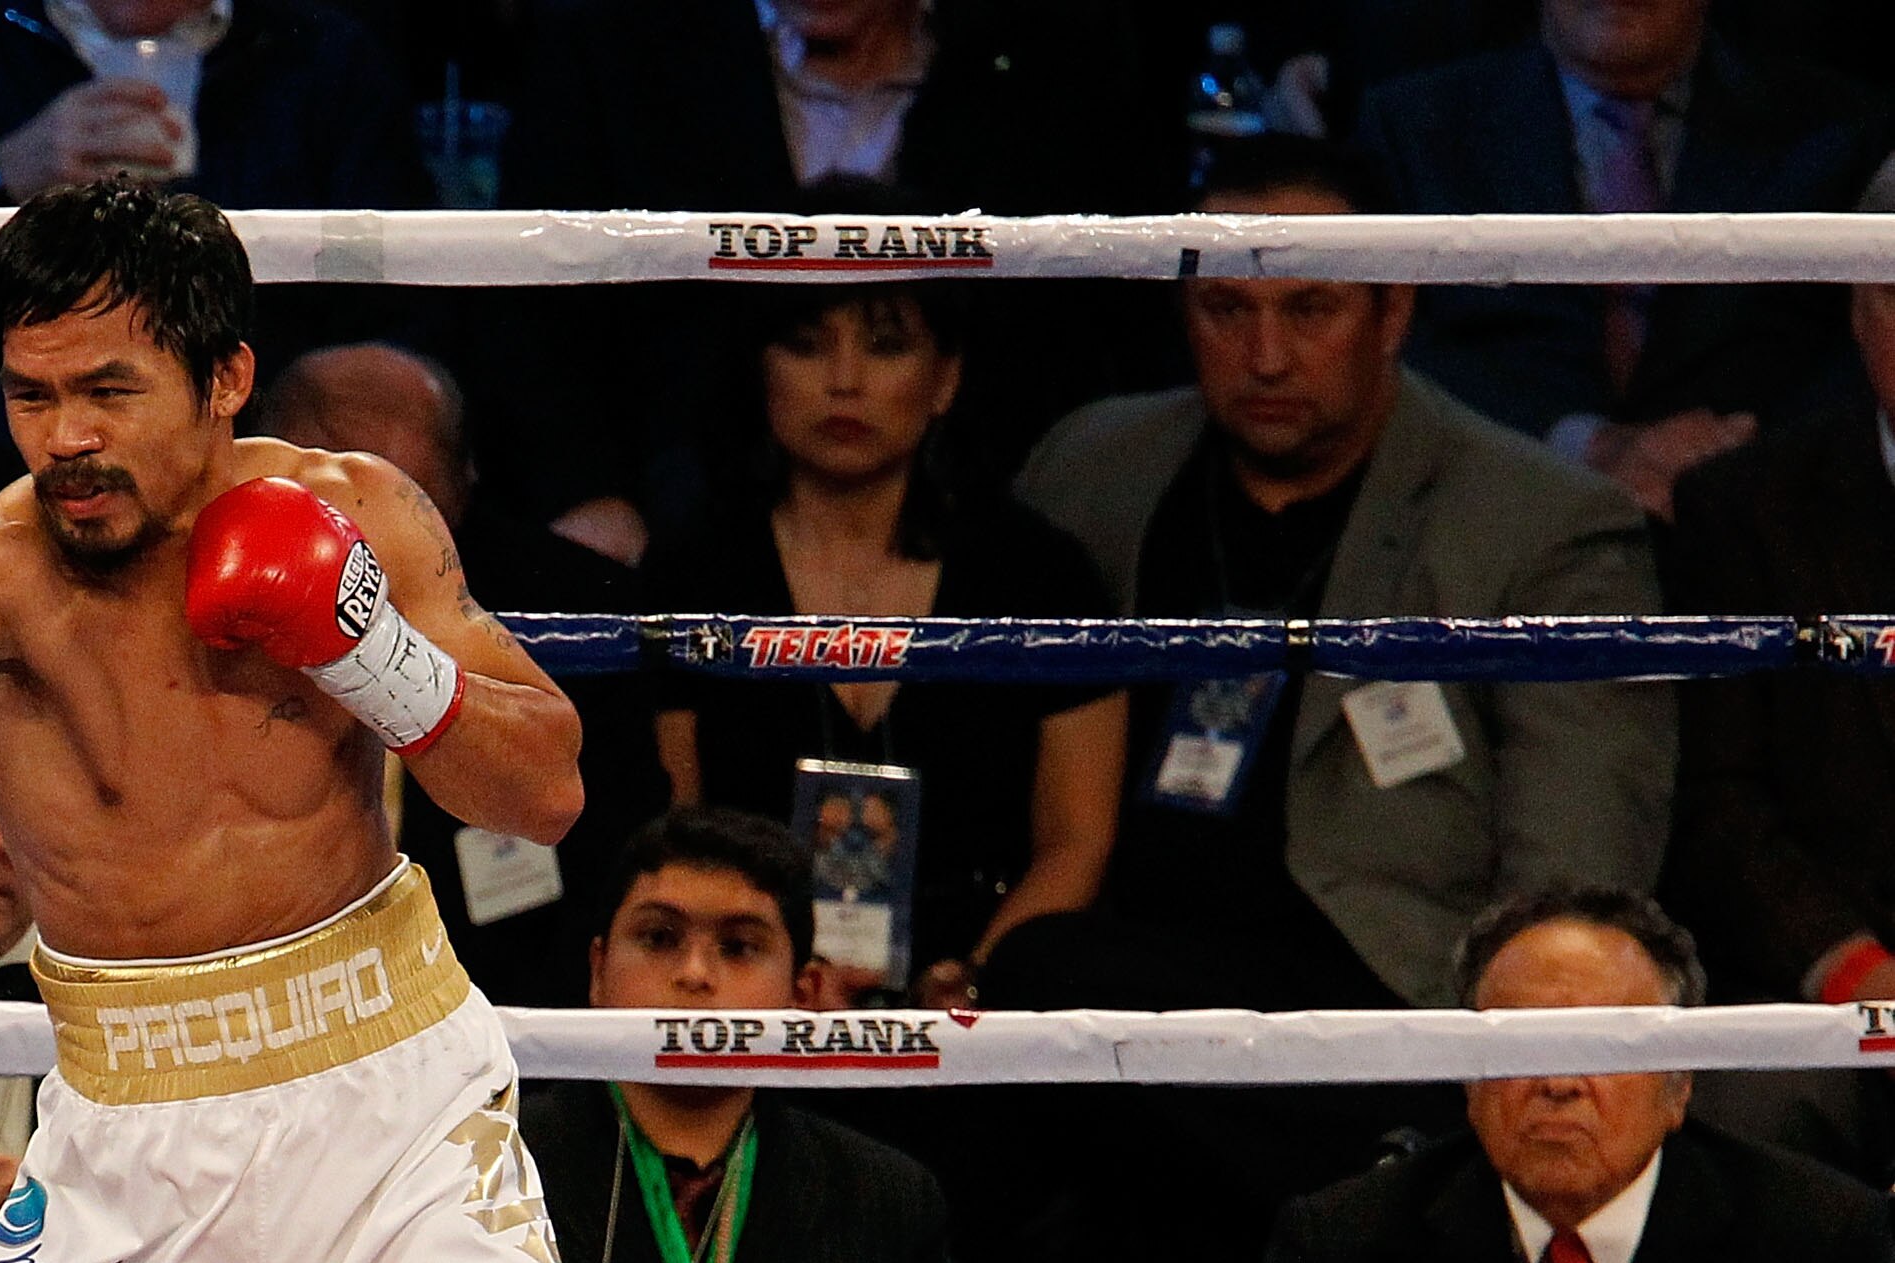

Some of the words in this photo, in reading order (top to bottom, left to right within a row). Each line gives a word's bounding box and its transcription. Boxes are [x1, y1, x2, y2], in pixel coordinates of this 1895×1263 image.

[708, 223, 818, 258] TOP
[834, 225, 994, 260] RANK
[343, 549, 383, 627] REYES
[742, 624, 916, 668] TECATE
[96, 946, 394, 1072] PACQUIAO
[655, 1019, 765, 1054] TOP
[781, 1020, 939, 1054] RANK
